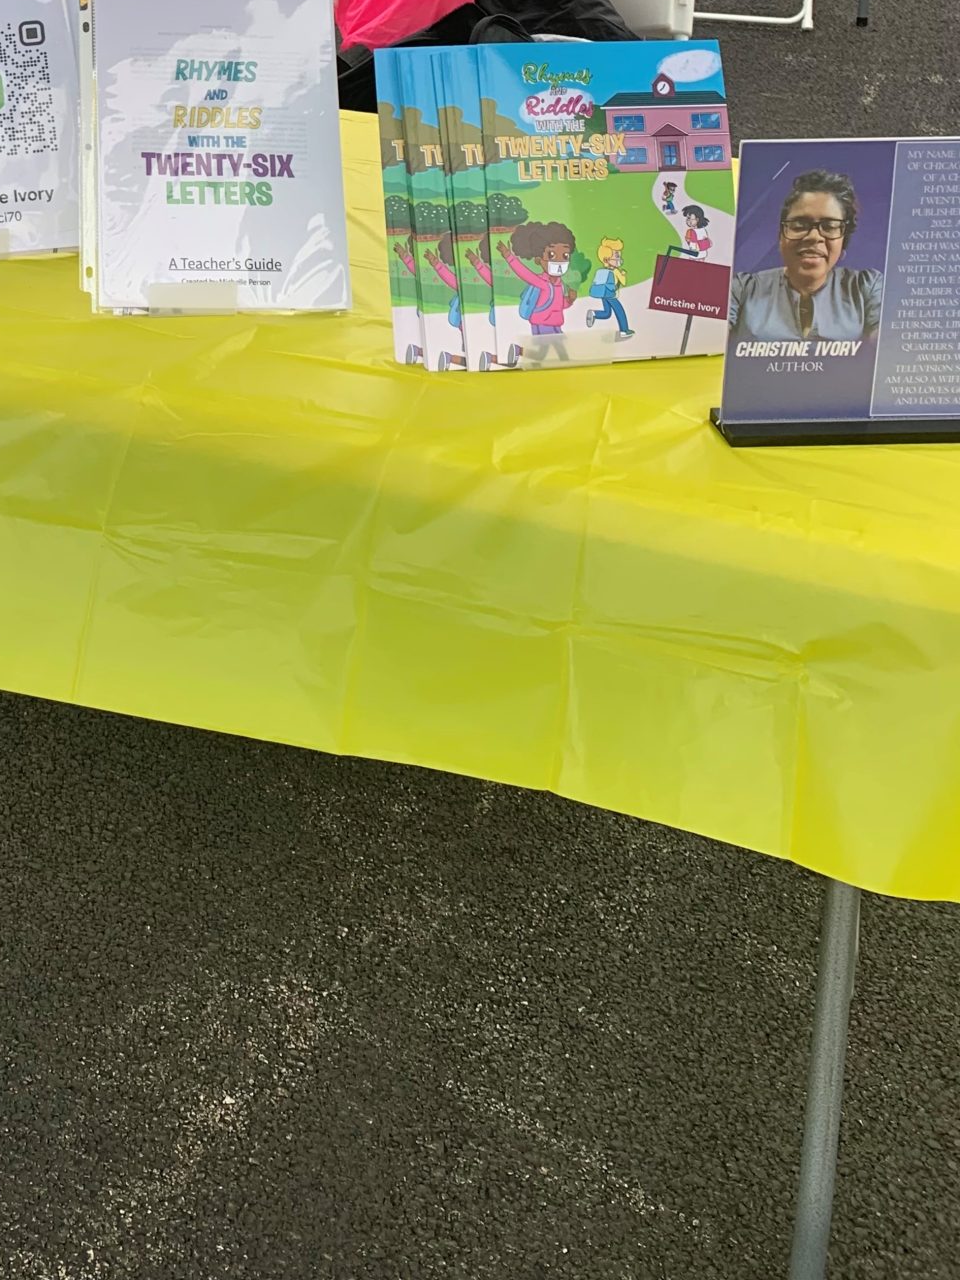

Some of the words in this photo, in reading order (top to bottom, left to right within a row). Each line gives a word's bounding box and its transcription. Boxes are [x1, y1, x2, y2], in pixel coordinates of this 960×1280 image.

[175, 58, 258, 83] RHYMES
[522, 63, 594, 87] Rhymes
[204, 88, 228, 101] AND
[525, 95, 594, 118] Riddles
[172, 106, 263, 130] RIDDLES
[535, 120, 563, 133] WITH
[564, 119, 586, 132] THE
[188, 135, 221, 148] WITH
[223, 136, 247, 148] THE
[495, 133, 627, 158] TWENTY-SIX
[141, 152, 295, 178] TWENTY-SIX
[518, 158, 609, 182] LETTERS
[13, 188, 54, 202] Ivory
[166, 181, 273, 206] LETTERS
[911, 208, 960, 216] PUBLISHE
[169, 258, 178, 269] A
[244, 258, 282, 271] Guide
[654, 296, 696, 309] Christine
[697, 302, 721, 315] Ivory
[735, 341, 812, 357] CHRISTINE
[814, 341, 863, 357] IVORY
[766, 361, 824, 372] AUTHOR
